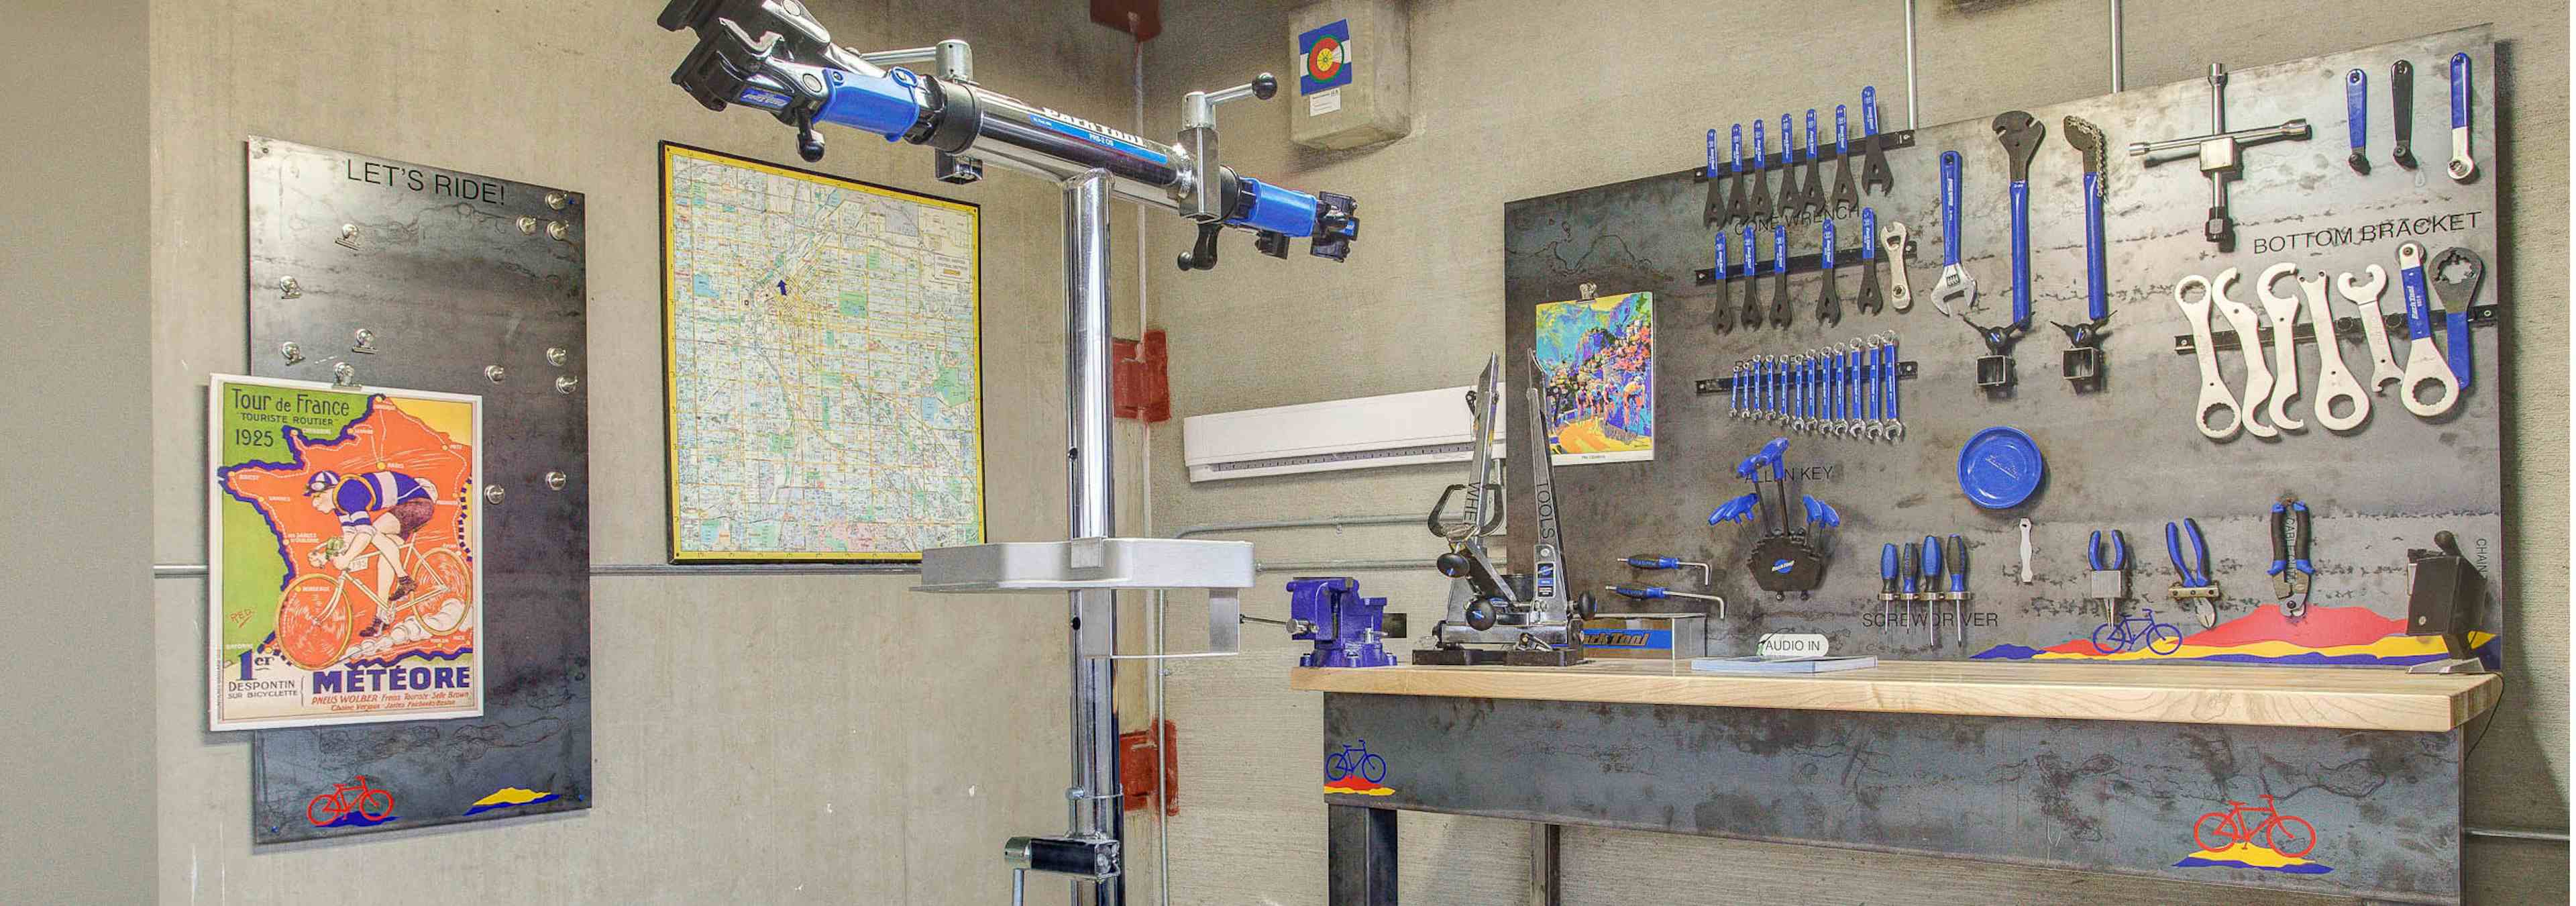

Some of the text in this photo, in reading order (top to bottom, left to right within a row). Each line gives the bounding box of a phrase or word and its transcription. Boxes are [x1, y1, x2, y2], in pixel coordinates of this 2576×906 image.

[346, 158, 505, 206] LET'S RIDE!
[2254, 211, 2483, 254] BOTTOM BRACKET
[231, 388, 350, 416] Tour de France
[235, 428, 274, 448] 1925
[1801, 466, 1833, 481] KEY
[1536, 483, 1556, 540] TOOLS
[1862, 612, 1998, 628] SCREWDRVER
[1766, 640, 1820, 651] AUDIO IN
[229, 680, 295, 692] DESPONTIN
[247, 690, 298, 699] BICYCLETTE
[311, 695, 338, 705] PNEUS
[339, 693, 378, 703] WOLBER
